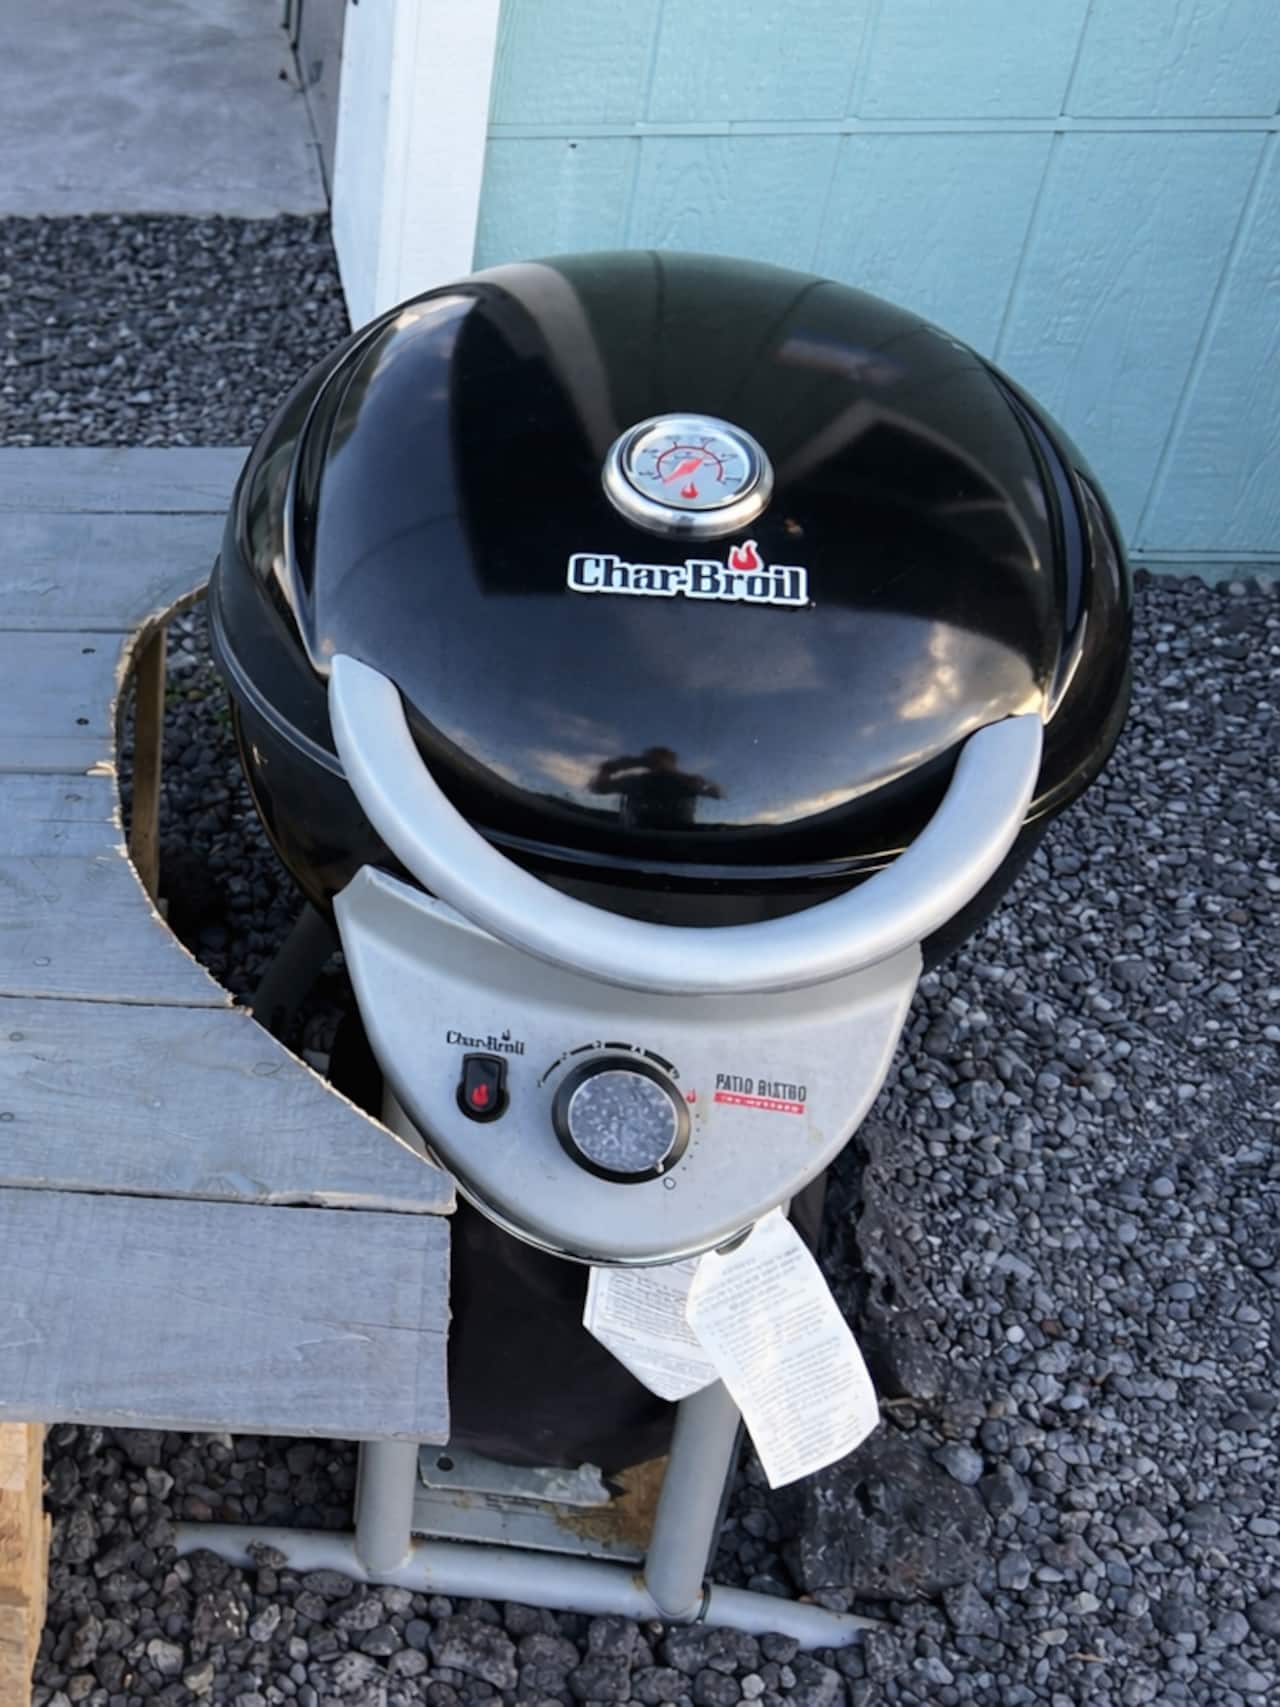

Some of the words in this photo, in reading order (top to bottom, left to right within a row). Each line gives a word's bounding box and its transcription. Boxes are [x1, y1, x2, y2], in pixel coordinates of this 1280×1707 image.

[569, 553, 808, 606] Char-Broil
[715, 1073, 754, 1095] PATIO
[757, 1079, 807, 1102] BISTRO
